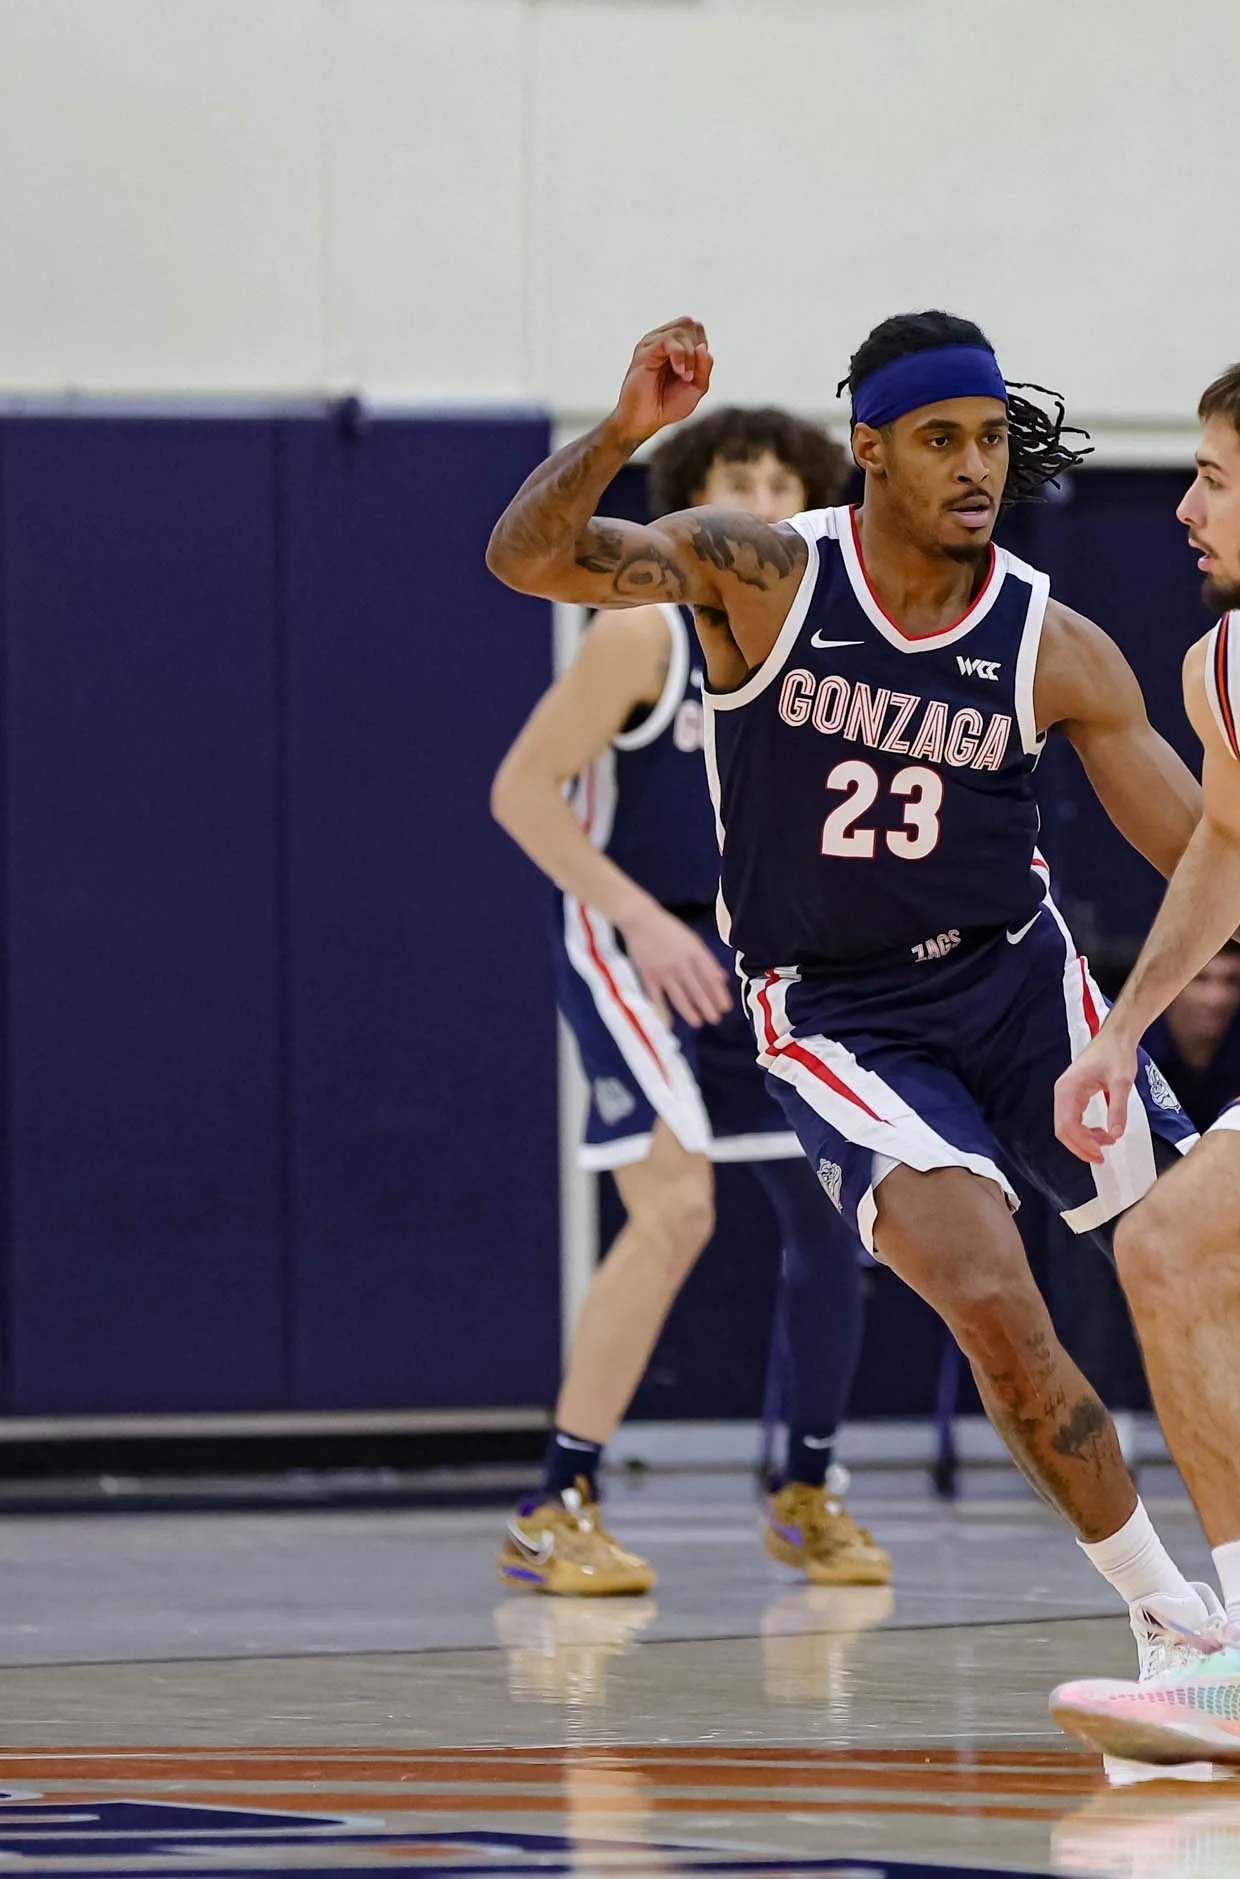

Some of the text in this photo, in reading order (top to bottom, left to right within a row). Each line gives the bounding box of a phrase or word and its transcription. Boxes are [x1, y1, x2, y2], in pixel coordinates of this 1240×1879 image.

[955, 656, 1002, 682] WCC
[778, 668, 1012, 771] GONZAGA
[821, 760, 944, 860] 23
[911, 928, 962, 963] ZAGS
